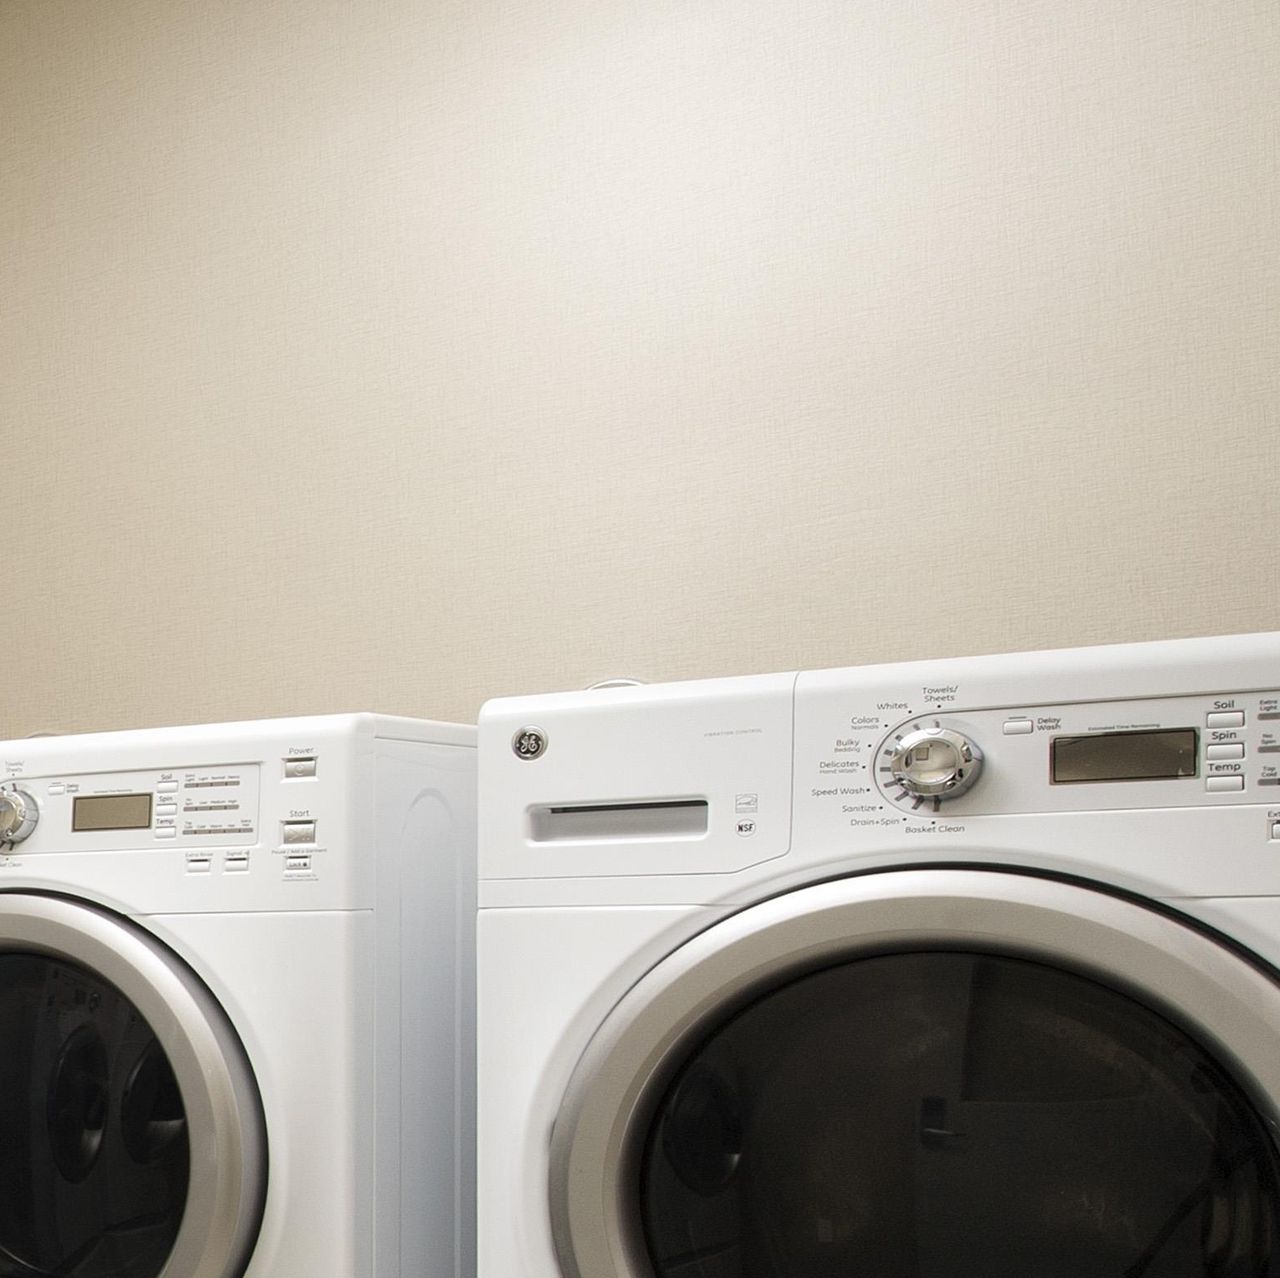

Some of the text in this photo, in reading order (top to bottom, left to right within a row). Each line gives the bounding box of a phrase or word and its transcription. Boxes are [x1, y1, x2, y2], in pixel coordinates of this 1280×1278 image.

[922, 685, 959, 694] Towels/
[924, 695, 955, 703] Sheets
[877, 702, 909, 710] Whites
[1214, 700, 1235, 709] Soil
[851, 716, 880, 725] Colors
[1037, 717, 1061, 725] Delay
[1037, 723, 1062, 731] Wash
[1211, 731, 1237, 741] Spin
[836, 739, 860, 747] Bulky
[288, 747, 314, 755] Power
[819, 760, 860, 769] Delicates
[1208, 763, 1241, 773] Temp
[811, 788, 838, 797] Speed
[737, 823, 753, 832] NSF
[905, 826, 936, 834] Basket
